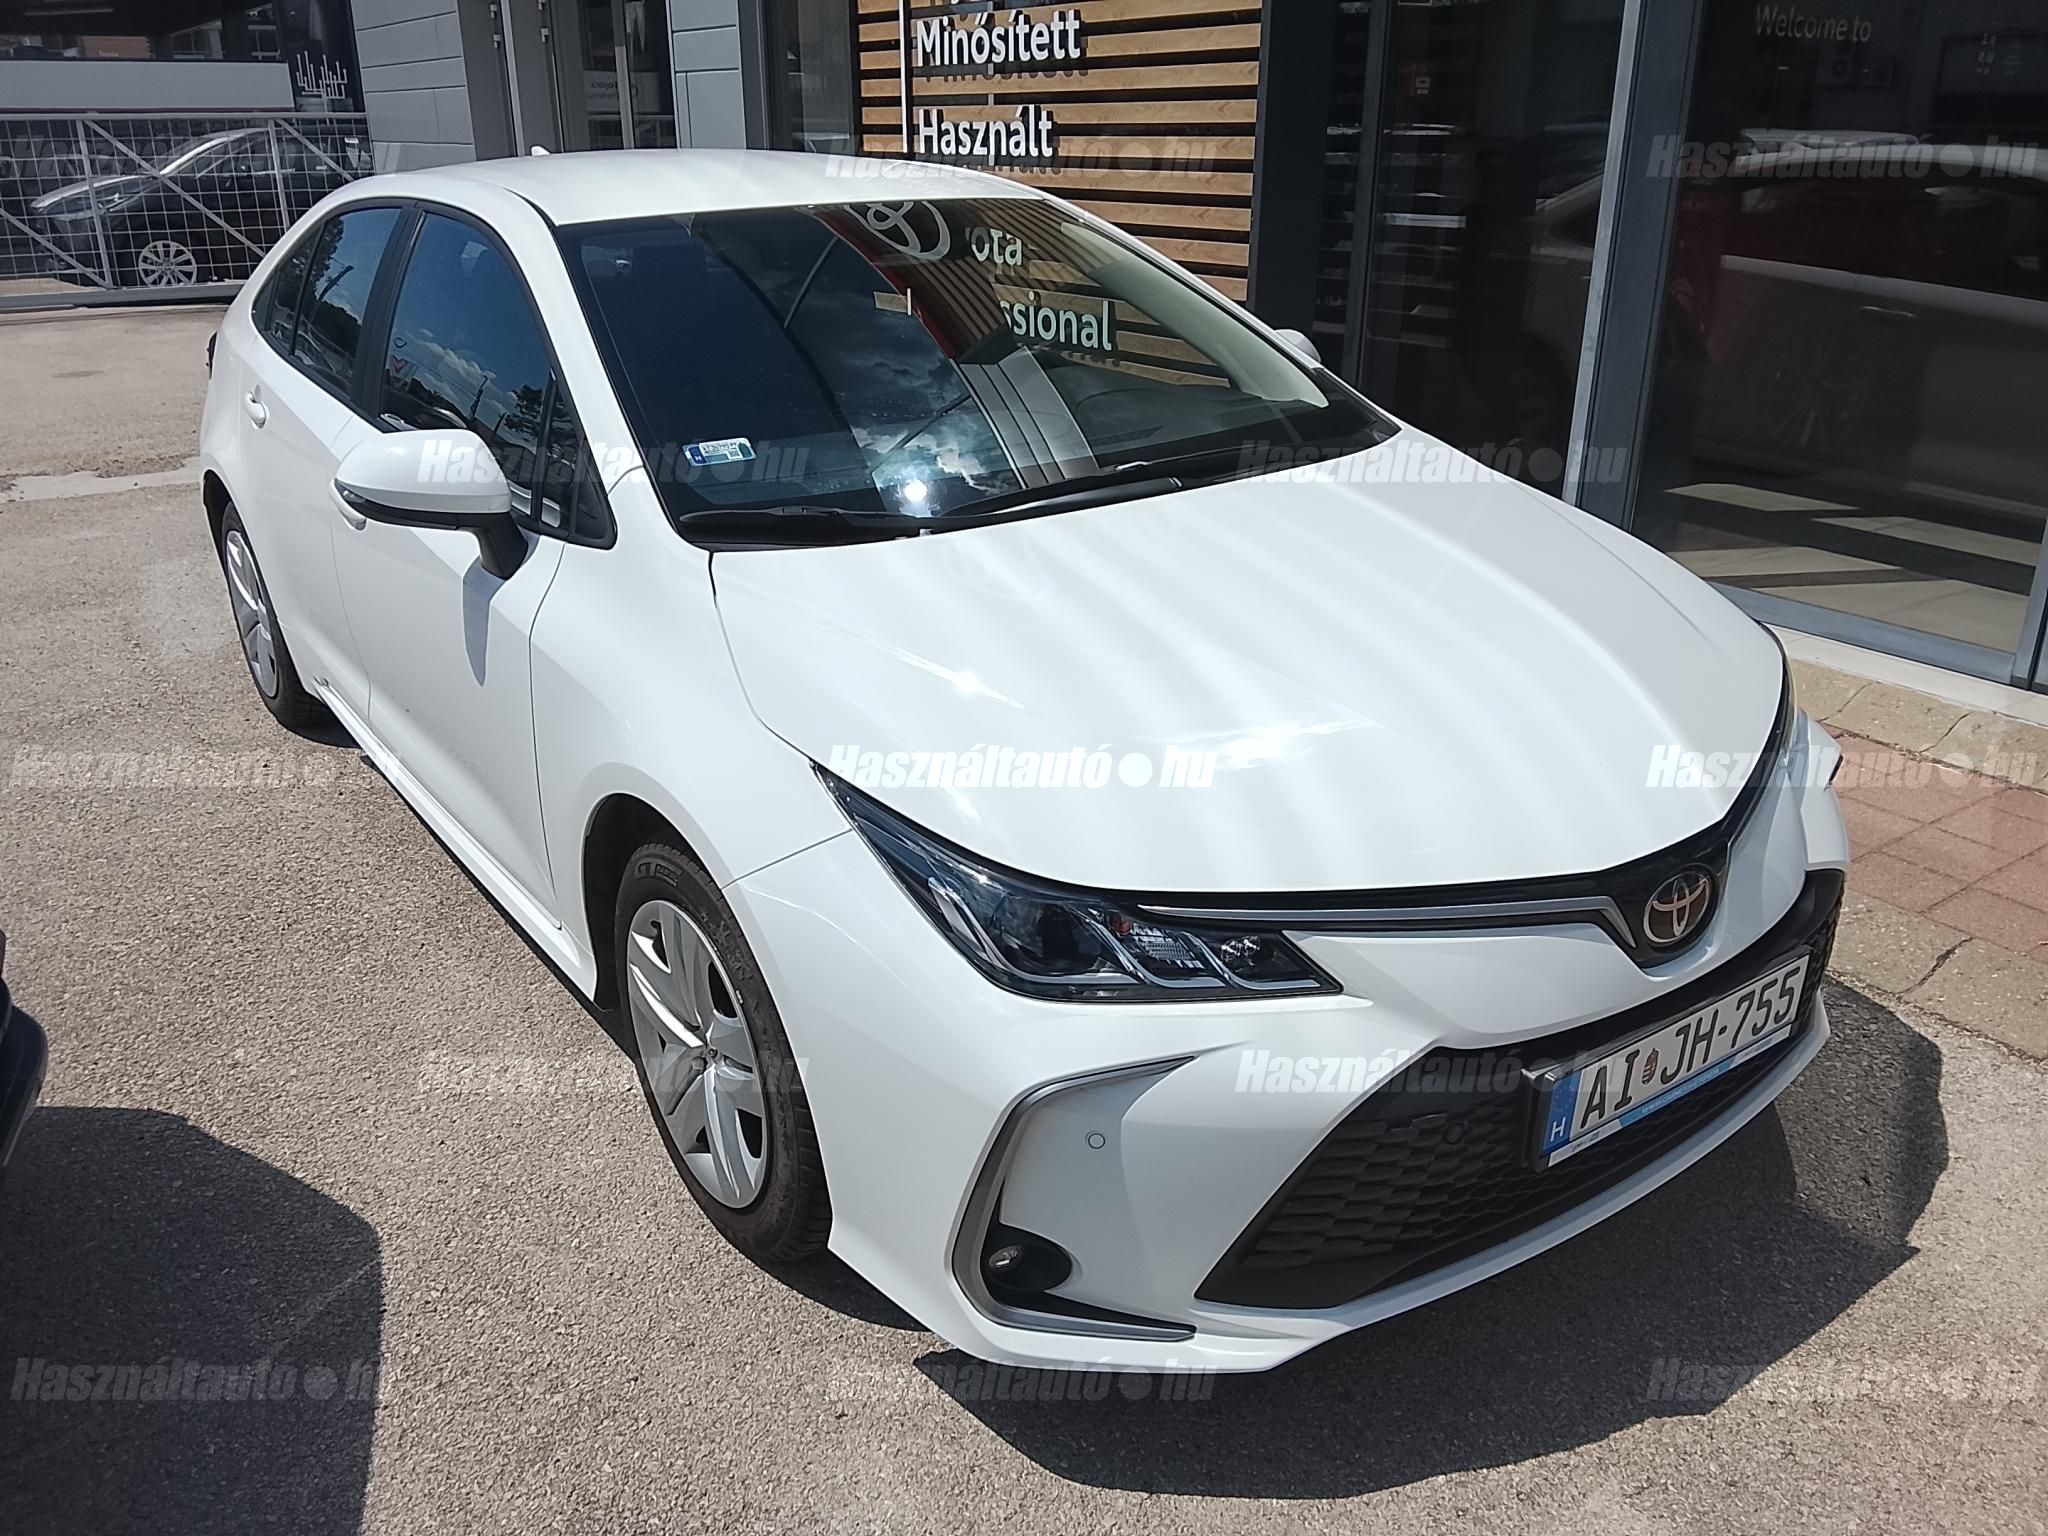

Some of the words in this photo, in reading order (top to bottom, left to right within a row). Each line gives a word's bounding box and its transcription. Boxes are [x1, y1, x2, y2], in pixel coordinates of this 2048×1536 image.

[916, 9, 1081, 66] Minősített
[1755, 4, 1848, 40] Welcome
[1853, 14, 1873, 42] to
[918, 104, 1053, 158] Használt
[1549, 1116, 1565, 1142] H
[1580, 1048, 1640, 1130] AI
